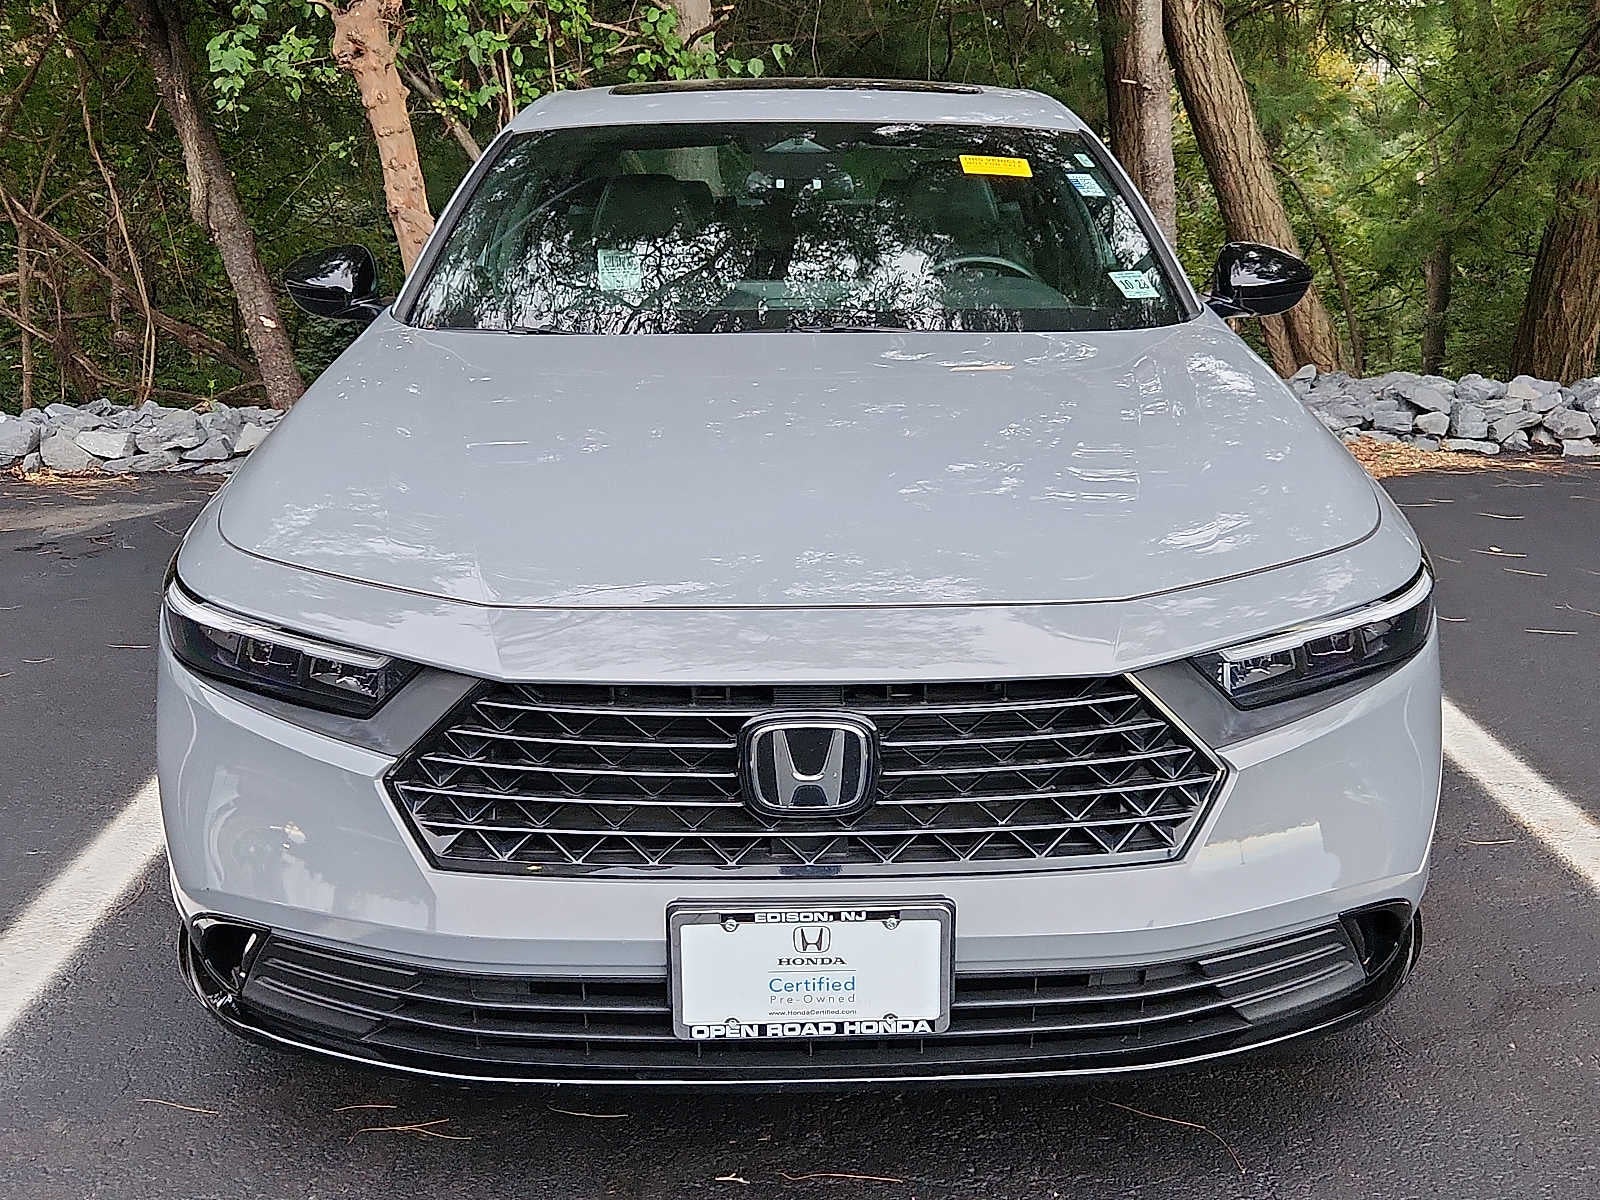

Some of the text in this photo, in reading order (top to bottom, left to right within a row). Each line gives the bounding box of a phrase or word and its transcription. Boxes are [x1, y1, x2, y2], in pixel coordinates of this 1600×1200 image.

[1119, 279, 1134, 290] 10
[754, 911, 867, 923] EDISON, NJ
[777, 957, 847, 966] HONDA
[768, 975, 856, 993] Certified
[769, 993, 856, 1004] Pre-Owned
[691, 1019, 933, 1039] OPEN ROAD HONDA
